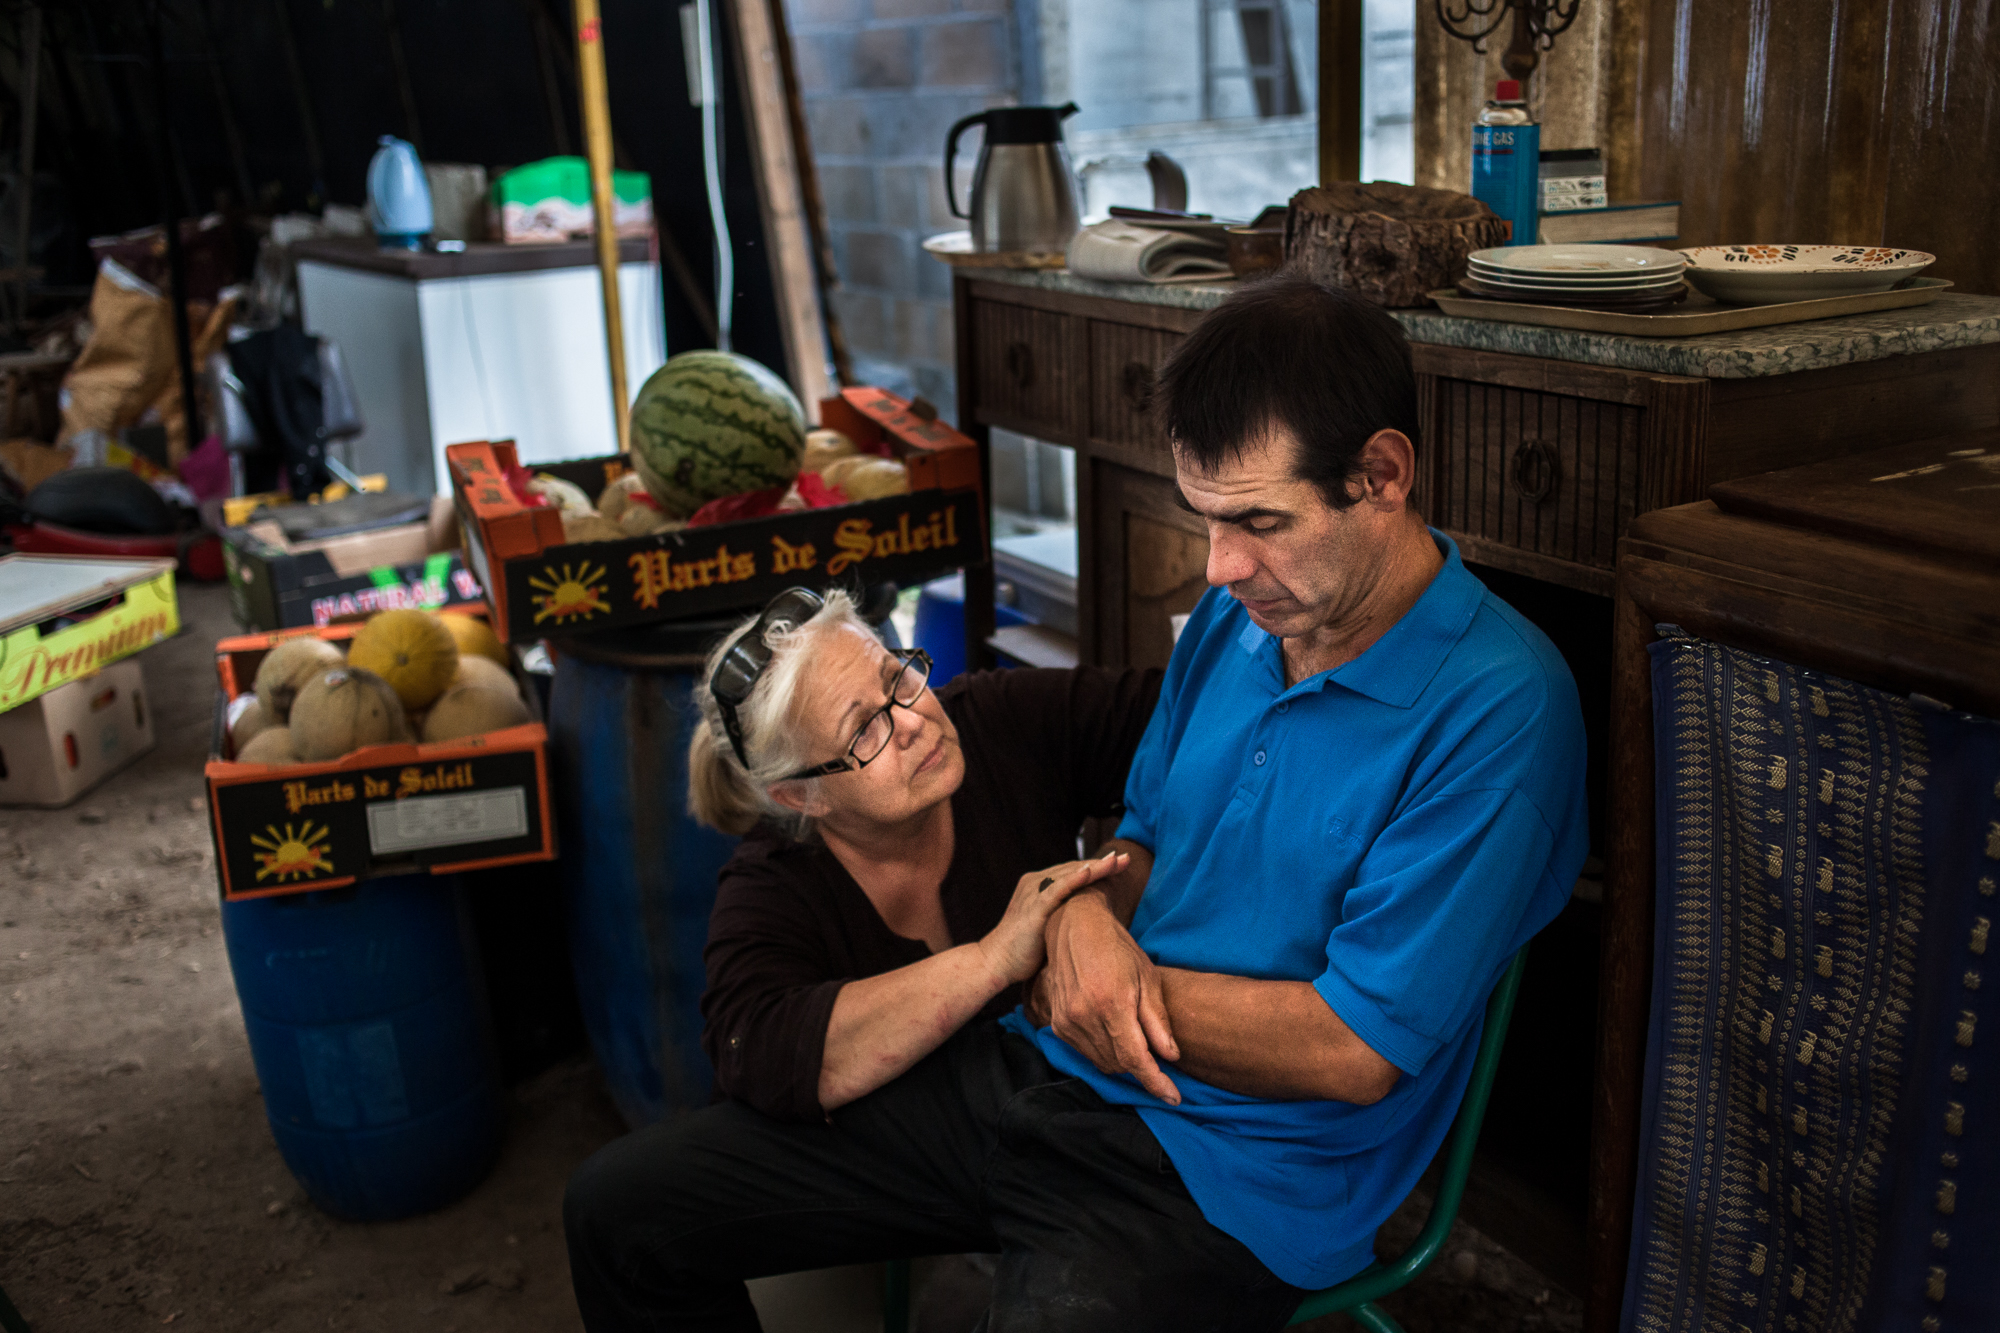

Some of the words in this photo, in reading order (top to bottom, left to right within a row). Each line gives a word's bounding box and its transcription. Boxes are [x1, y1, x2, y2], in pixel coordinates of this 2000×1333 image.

[1493, 131, 1515, 146] GAS
[770, 534, 817, 576] de
[826, 504, 960, 577] Soleil
[363, 773, 392, 799] de
[394, 761, 475, 800] Soleil
